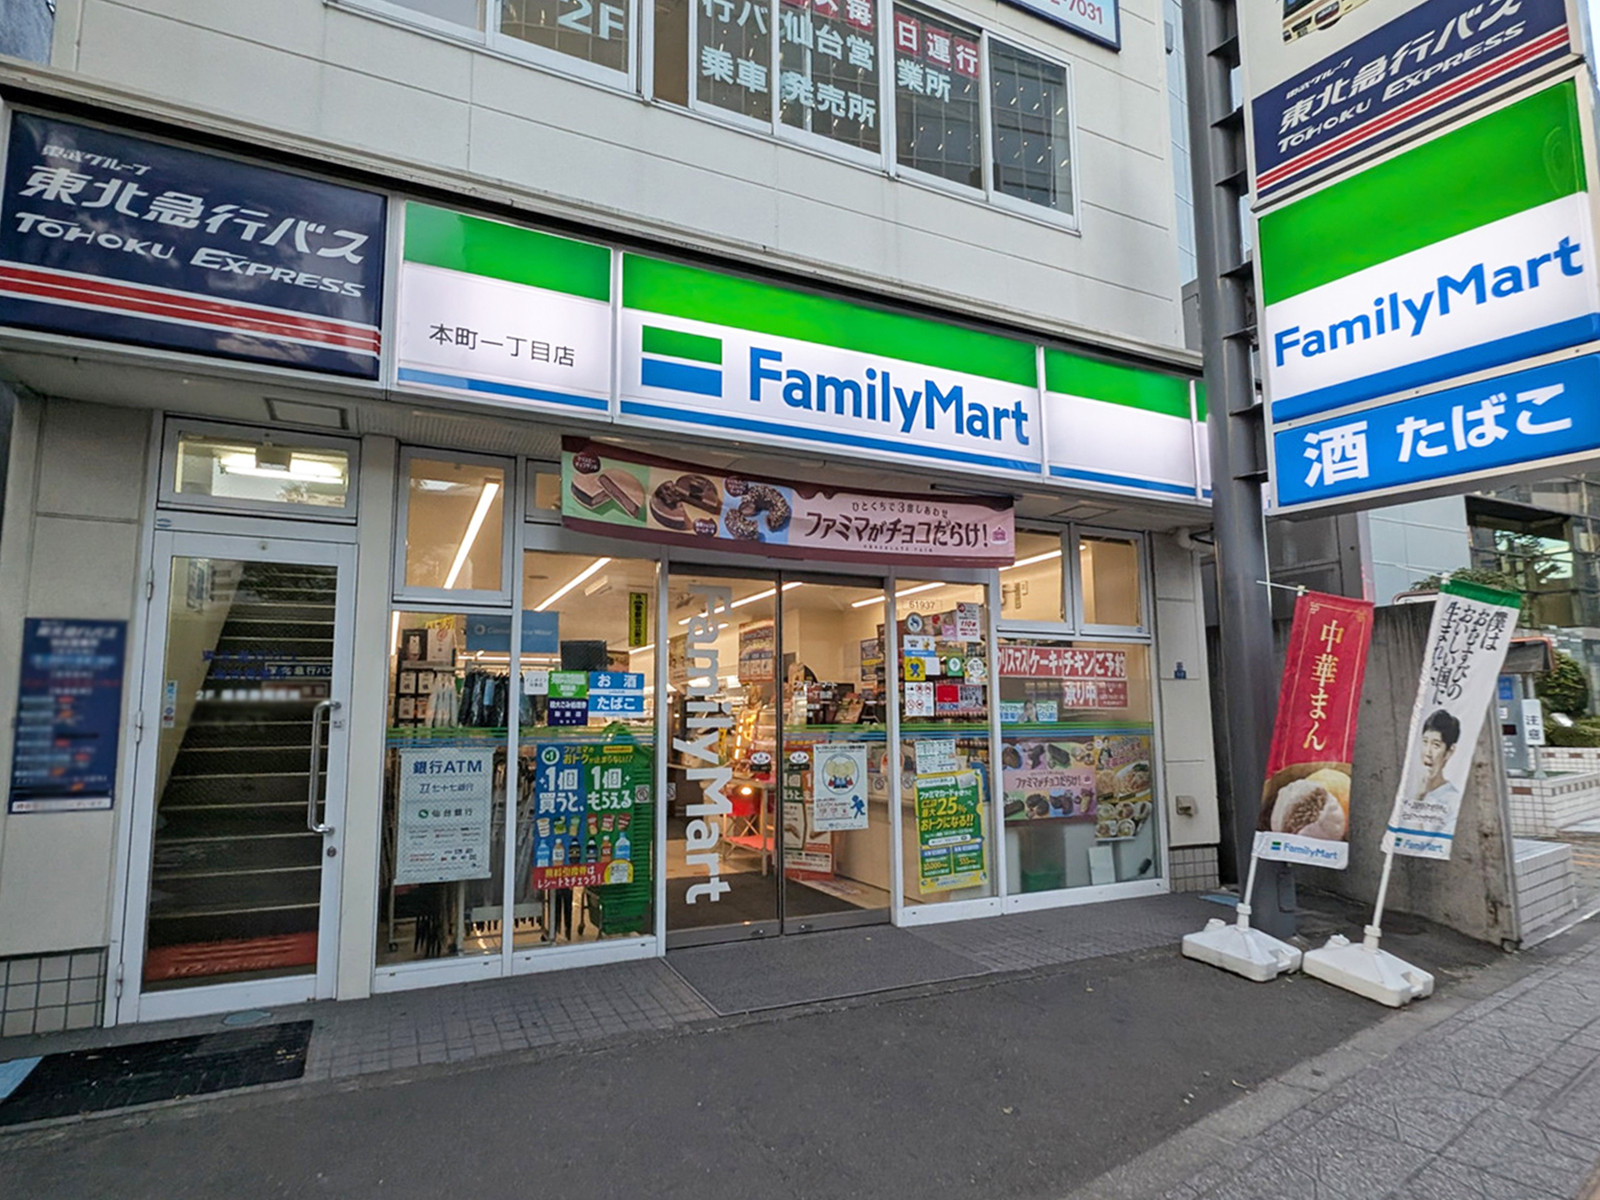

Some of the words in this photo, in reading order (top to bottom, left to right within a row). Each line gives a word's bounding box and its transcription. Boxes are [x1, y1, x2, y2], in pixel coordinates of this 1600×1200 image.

[557, 0, 624, 40] 2F
[1277, 98, 1372, 153] TOHOKU
[1381, 20, 1527, 103] EXPRESS
[1278, 0, 1523, 135] 東北急行バス
[15, 211, 175, 260] TOHOKU
[190, 247, 366, 298] EXPRESS
[18, 164, 369, 264] 東北急行バス
[429, 323, 575, 367] 本町一丁目店
[1274, 236, 1584, 367] FamilyMart
[750, 346, 1029, 445] FamilyMart
[1303, 420, 1370, 488] 酒
[1396, 382, 1573, 463] たばこ
[597, 696, 635, 710] たばこ
[1303, 619, 1344, 751] 中華まん
[413, 760, 482, 774] 銀行ATM
[545, 767, 578, 791] 1個
[591, 766, 622, 790] 1個
[673, 584, 732, 904] FamilyMart
[587, 790, 632, 811] もらえる
[1283, 842, 1338, 860] FamilyMart
